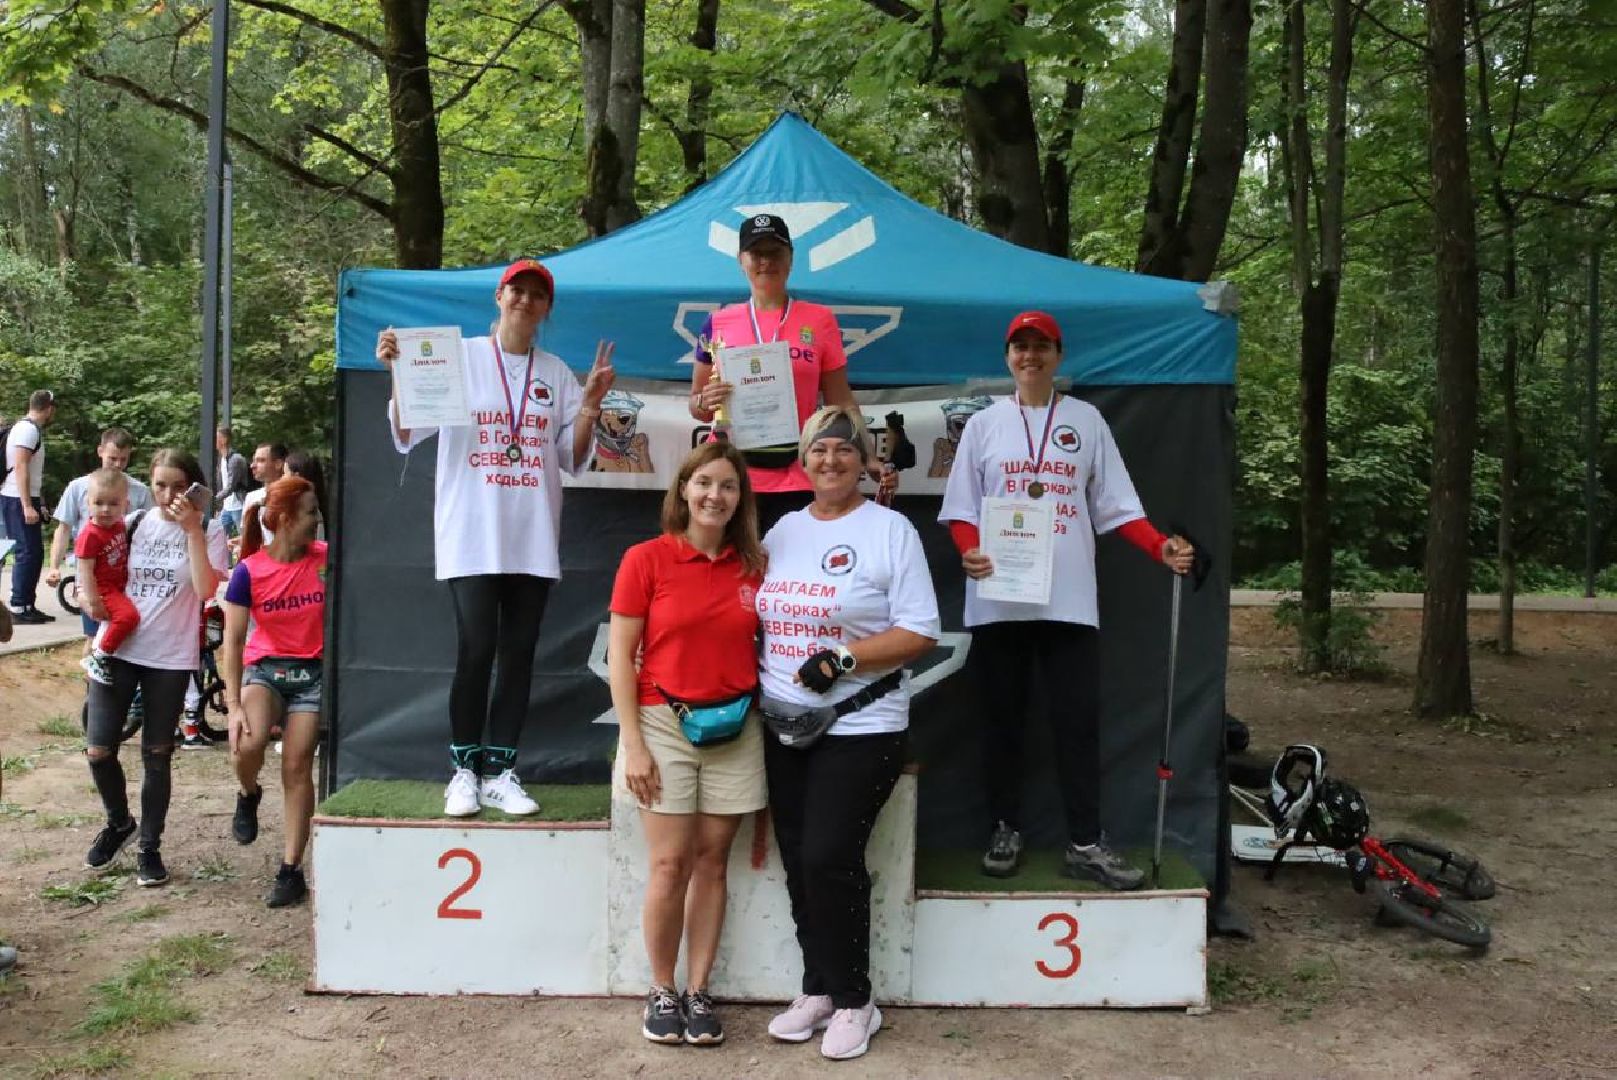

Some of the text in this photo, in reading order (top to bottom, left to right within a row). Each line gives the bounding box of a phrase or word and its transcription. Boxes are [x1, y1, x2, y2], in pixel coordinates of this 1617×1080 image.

[471, 410, 548, 431] "ШАГЕМ
[469, 452, 545, 469] СЕВЕНА
[1000, 460, 1076, 478] "ШААЕМ
[486, 473, 539, 488] ходьба
[133, 567, 175, 582] ТРОЕ
[132, 581, 178, 598] ДЕТЕЙ
[763, 620, 842, 639] ЕВЕРНАЯ
[274, 669, 311, 683] FILA
[437, 847, 482, 920] 2
[1035, 912, 1082, 979] 3
